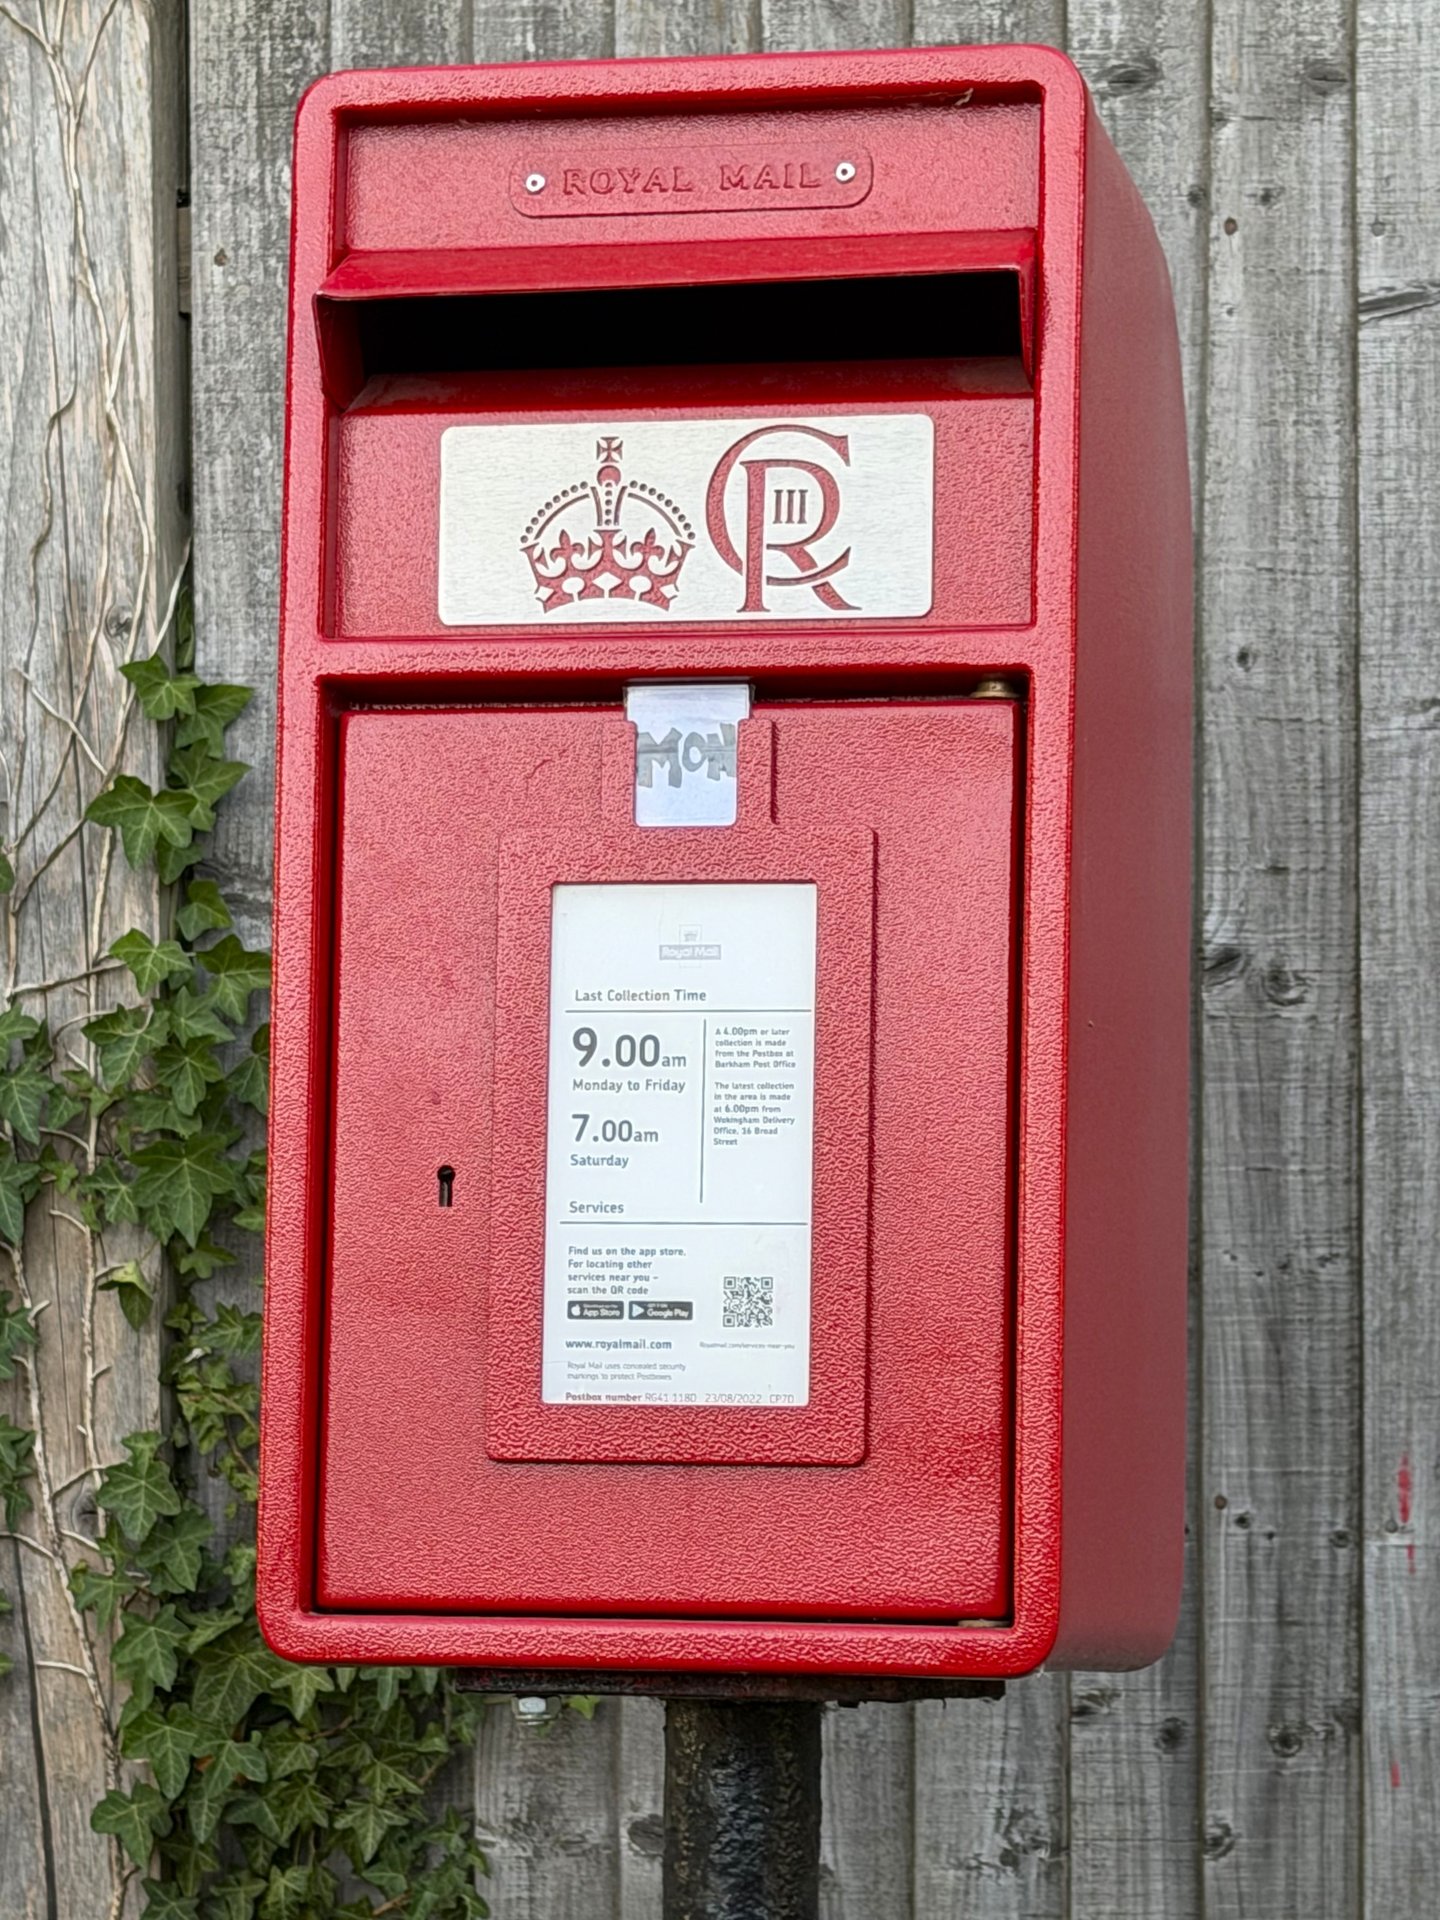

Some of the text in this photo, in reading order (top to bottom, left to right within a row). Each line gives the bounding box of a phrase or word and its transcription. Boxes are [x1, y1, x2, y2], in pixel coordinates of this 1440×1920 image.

[562, 162, 821, 195] ROYAL MAIL
[575, 989, 707, 1001] Last Collection Time
[724, 1028, 757, 1037] 4.00pm
[715, 1039, 752, 1047] collection
[753, 1060, 771, 1068] Post
[773, 1060, 796, 1068] Office
[573, 1079, 685, 1093] Monday to Friday
[757, 1082, 794, 1090] collection
[769, 1093, 791, 1101] made
[725, 1104, 759, 1114] 6.00pm
[762, 1105, 781, 1113] from
[714, 1116, 795, 1126] Wokingham Delivery
[572, 1113, 659, 1143] 7.00am
[714, 1127, 739, 1135] Office,
[754, 1127, 778, 1135] Broad
[714, 1138, 738, 1146] Street
[570, 1154, 629, 1169] Saturday
[569, 1201, 624, 1214] Services
[568, 1247, 588, 1256] Find
[606, 1248, 617, 1256] on
[621, 1248, 636, 1256] the
[639, 1249, 656, 1258] app
[659, 1248, 686, 1256] store.
[568, 1260, 652, 1270] For locating other
[568, 1273, 606, 1281] services
[633, 1274, 650, 1283] you
[567, 1286, 648, 1295] scan the QR code
[583, 1309, 599, 1317] App
[647, 1309, 688, 1318] Google Play
[566, 1339, 672, 1351] www.royalmail.com
[567, 1362, 586, 1371] Royal
[588, 1362, 602, 1370] Mail
[659, 1363, 686, 1371] security
[567, 1372, 598, 1381] markings
[601, 1372, 608, 1380] to
[610, 1373, 635, 1381] protect
[566, 1392, 601, 1401] Postbox
[606, 1394, 641, 1402] number
[645, 1394, 668, 1402] RG41
[705, 1394, 762, 1403] 23/08/2022
